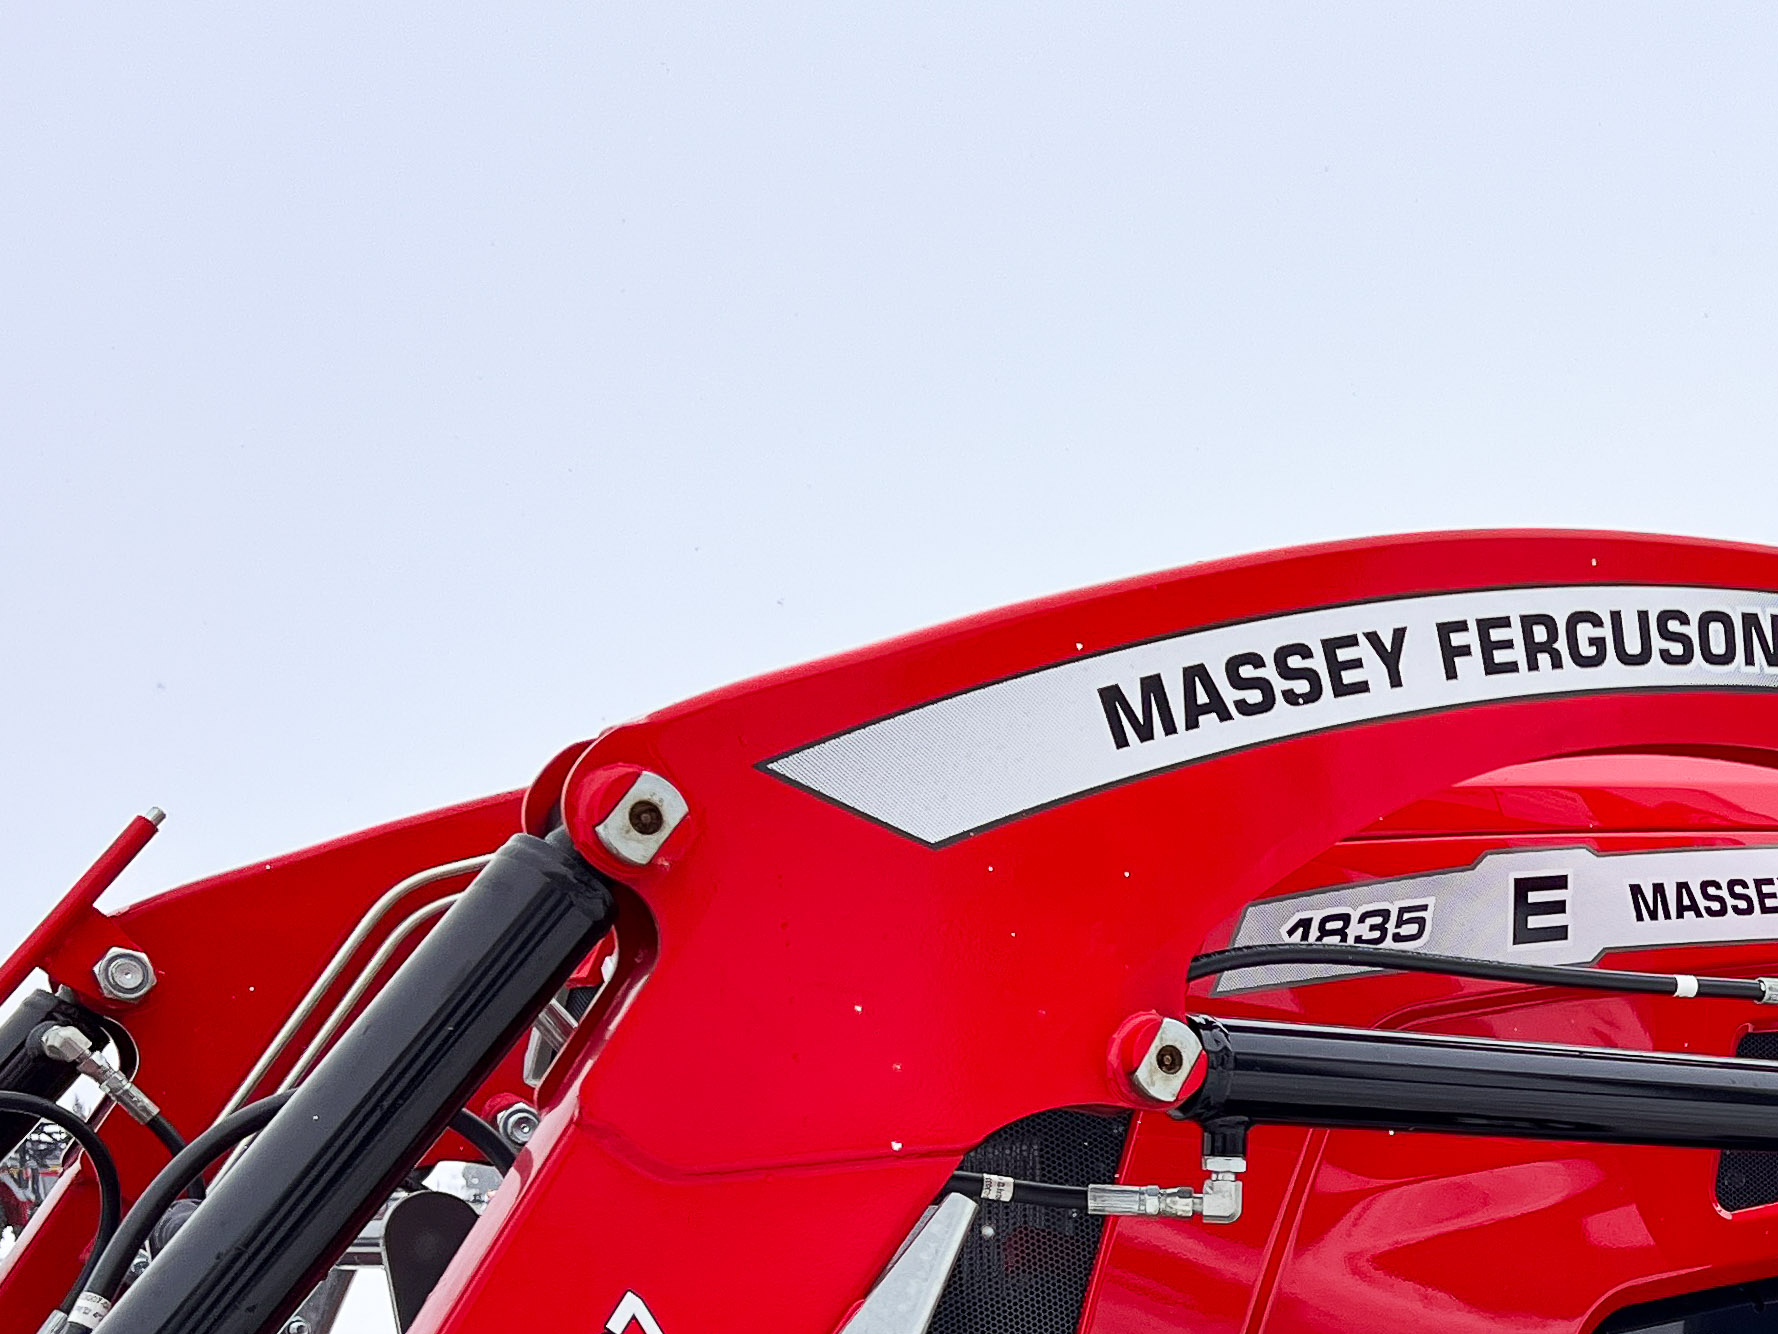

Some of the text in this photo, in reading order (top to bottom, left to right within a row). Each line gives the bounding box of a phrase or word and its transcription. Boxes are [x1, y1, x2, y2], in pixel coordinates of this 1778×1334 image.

[1097, 625, 1408, 751] MASSEY
[1285, 903, 1430, 946] 1835
[1512, 873, 1569, 946] E
